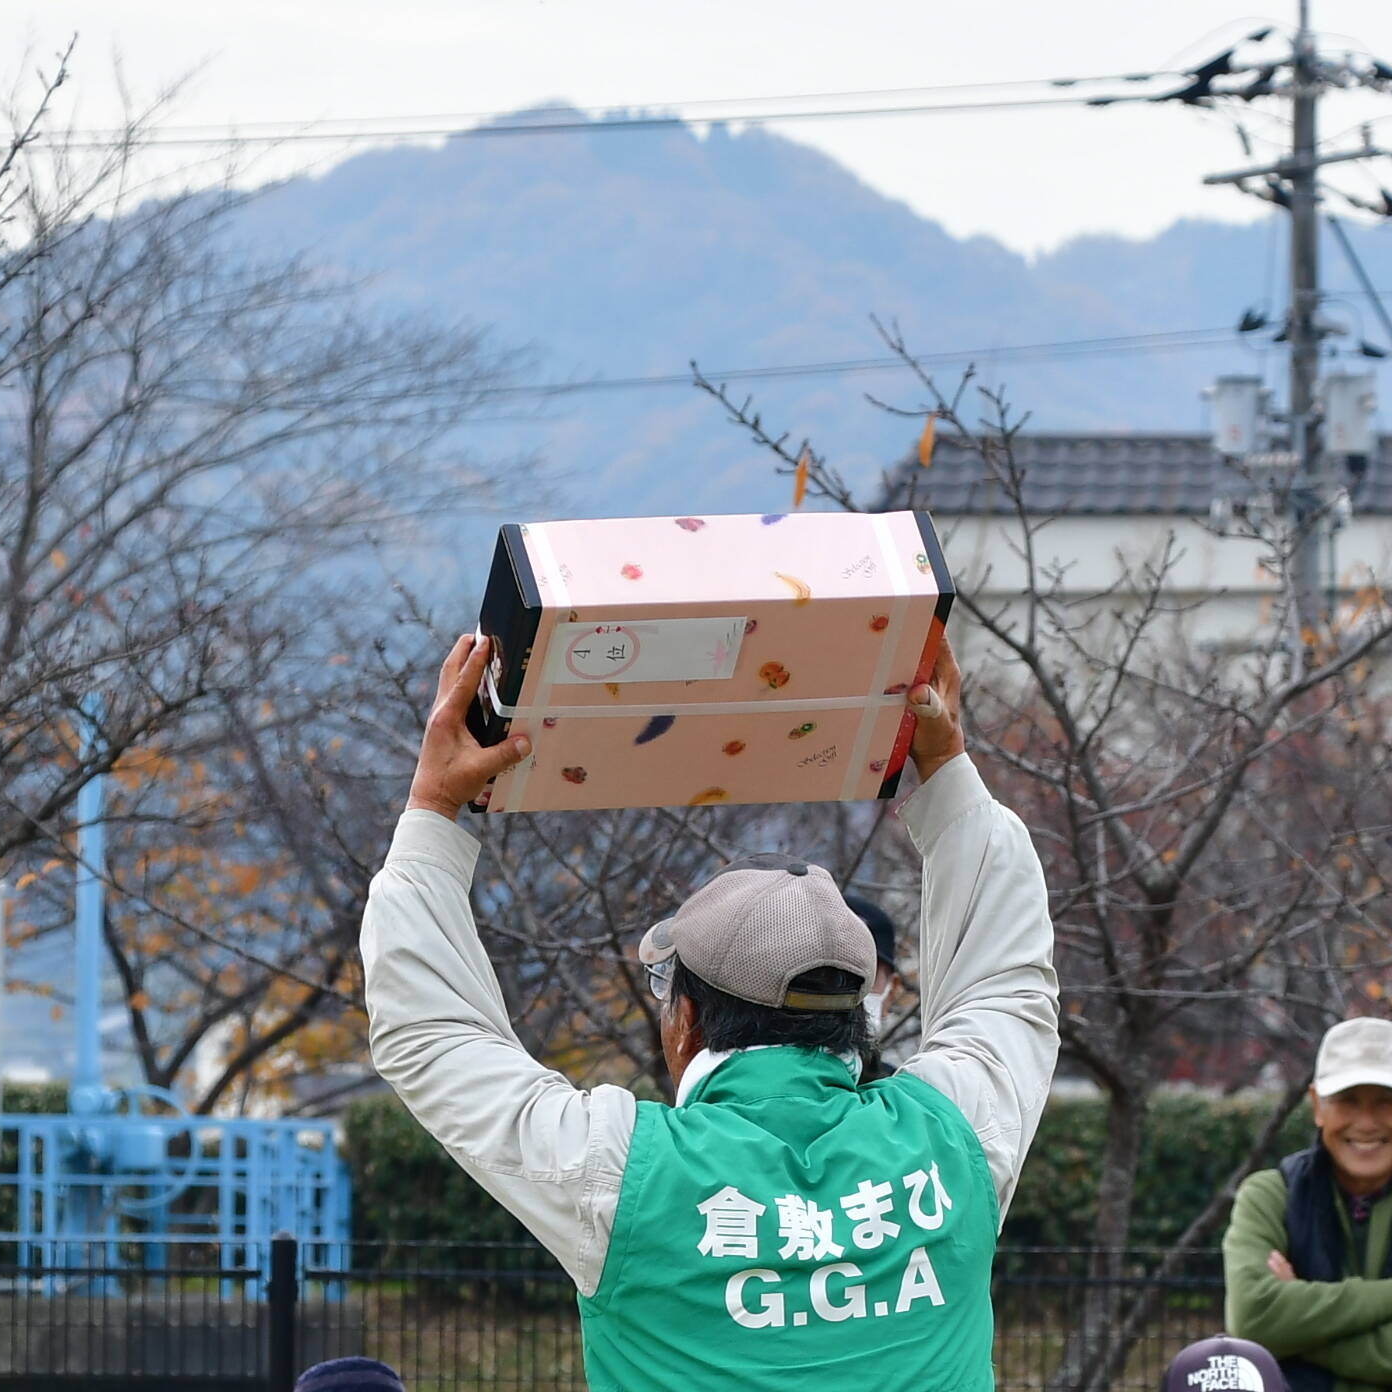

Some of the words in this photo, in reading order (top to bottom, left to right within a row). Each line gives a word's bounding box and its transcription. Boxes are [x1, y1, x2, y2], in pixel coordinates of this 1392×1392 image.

[724, 1246, 946, 1330] G.G.A
[1207, 1354, 1238, 1369] THE
[1187, 1367, 1239, 1387] NORTH
[1200, 1378, 1239, 1392] FACE
